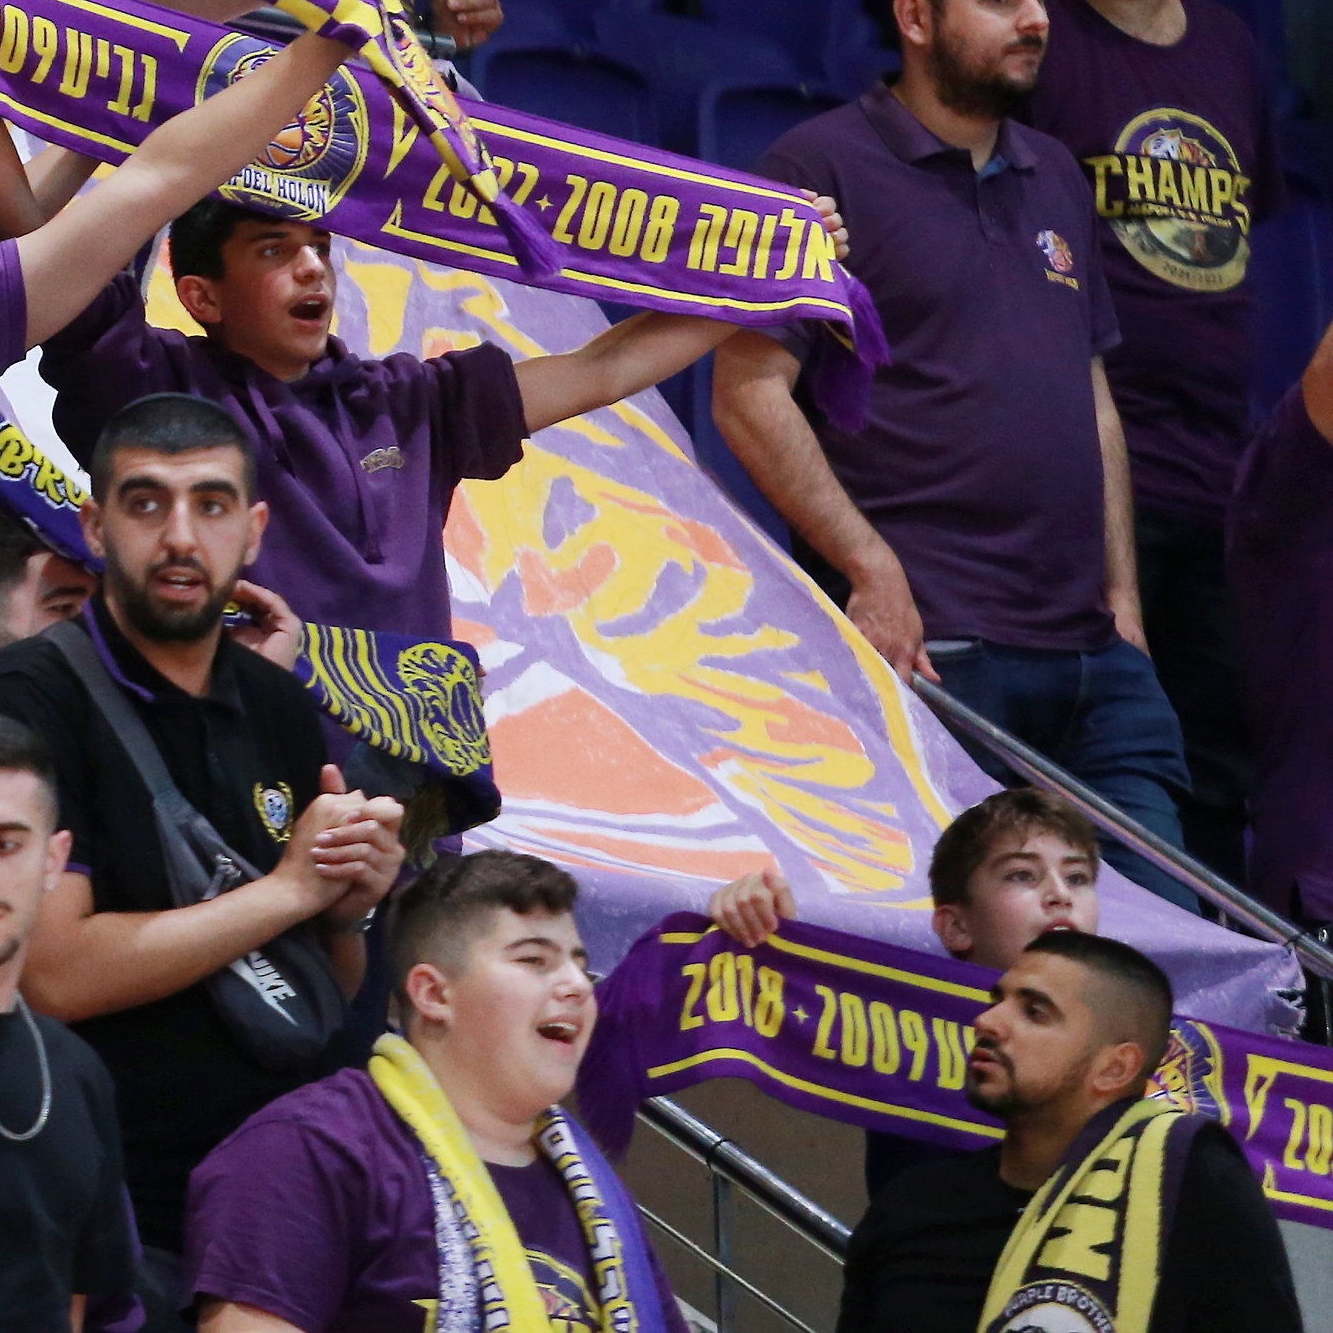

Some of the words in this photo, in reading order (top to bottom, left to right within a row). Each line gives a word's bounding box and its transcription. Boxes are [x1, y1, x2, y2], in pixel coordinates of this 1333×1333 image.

[58, 27, 159, 123] גביע
[275, 174, 331, 214] HOLON
[552, 173, 681, 264] 2008
[1083, 153, 1252, 236] CHAMPS
[686, 203, 837, 283] אלופה
[679, 951, 786, 1040] 2018
[813, 983, 930, 1076] 2009
